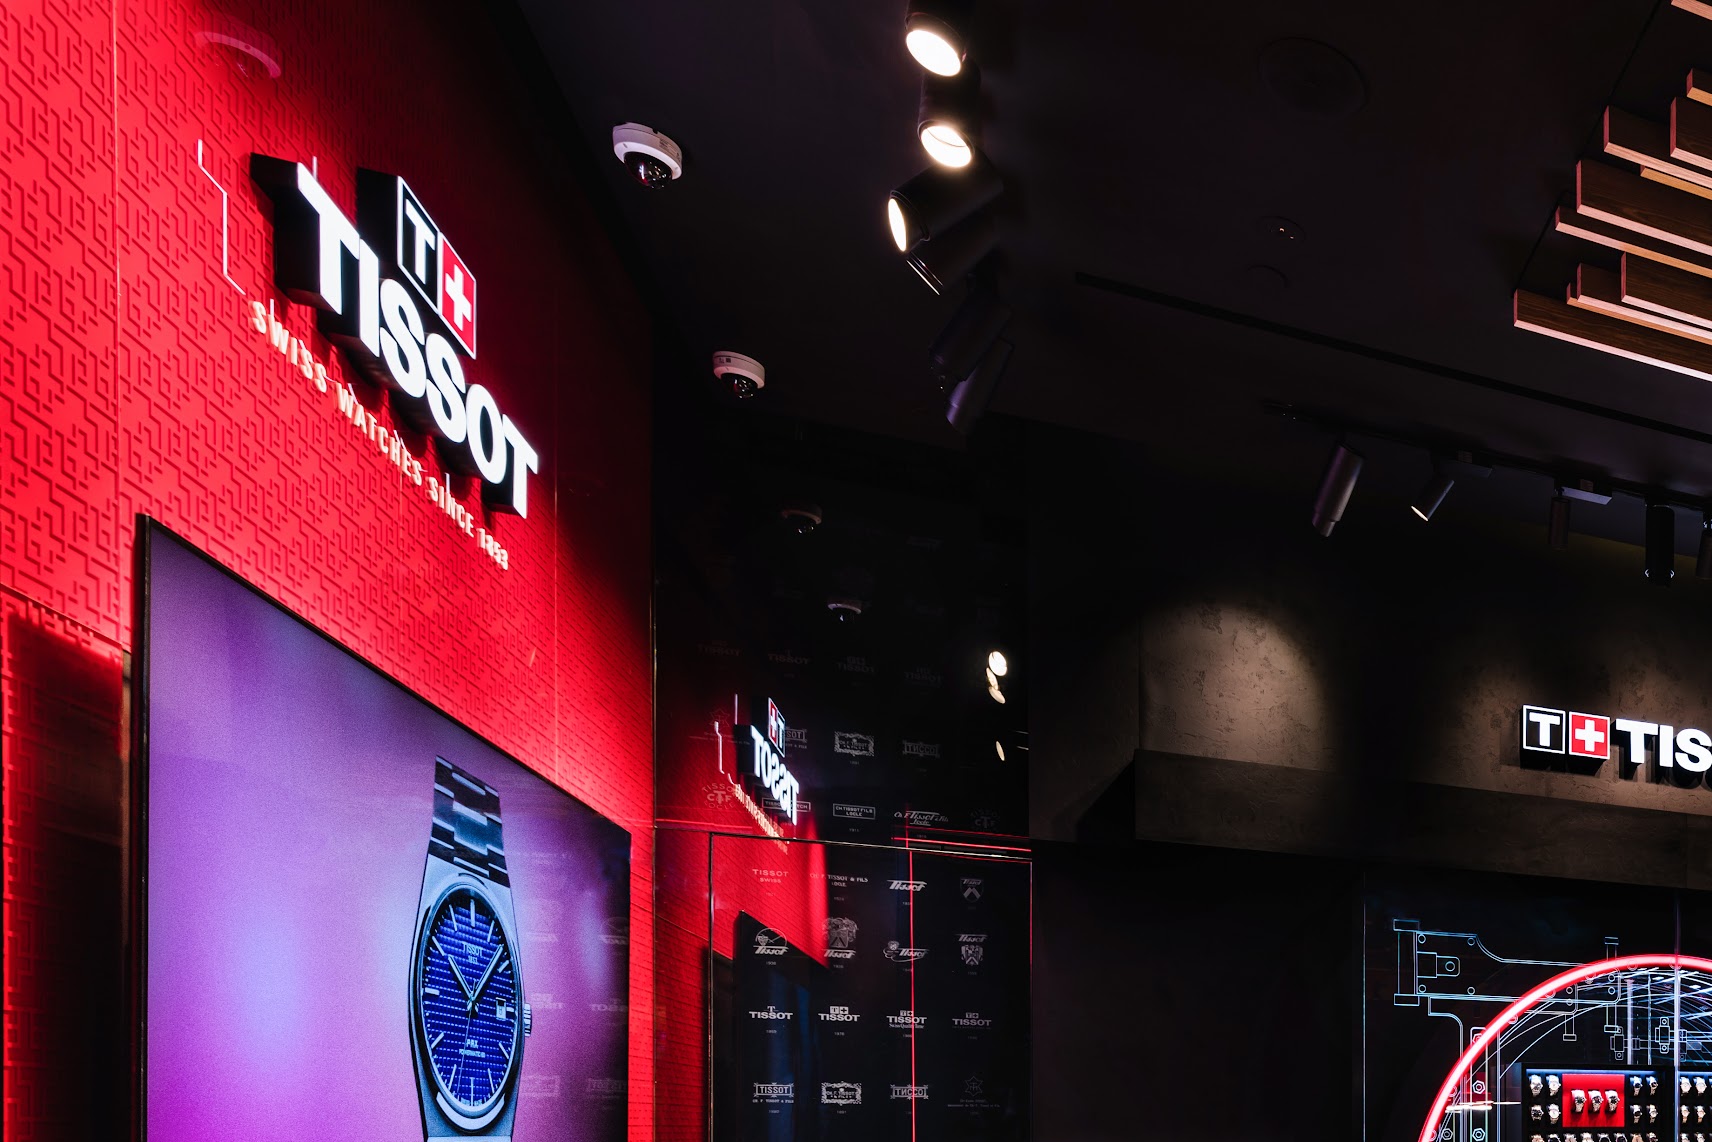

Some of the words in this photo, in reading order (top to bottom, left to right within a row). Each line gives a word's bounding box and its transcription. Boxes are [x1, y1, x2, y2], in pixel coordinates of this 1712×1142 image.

[405, 199, 435, 284] T
[298, 162, 538, 518] TISSOT
[252, 300, 327, 393] SWISS
[335, 387, 423, 487] WATCHES
[428, 475, 475, 538] SINCE
[477, 527, 509, 571] 1853
[752, 869, 789, 877] TISSOT
[749, 1011, 794, 1020] TISSOT
[818, 1013, 860, 1022] TISSOT
[886, 1015, 927, 1024] TISSOT
[759, 1086, 789, 1094] TISSOT
